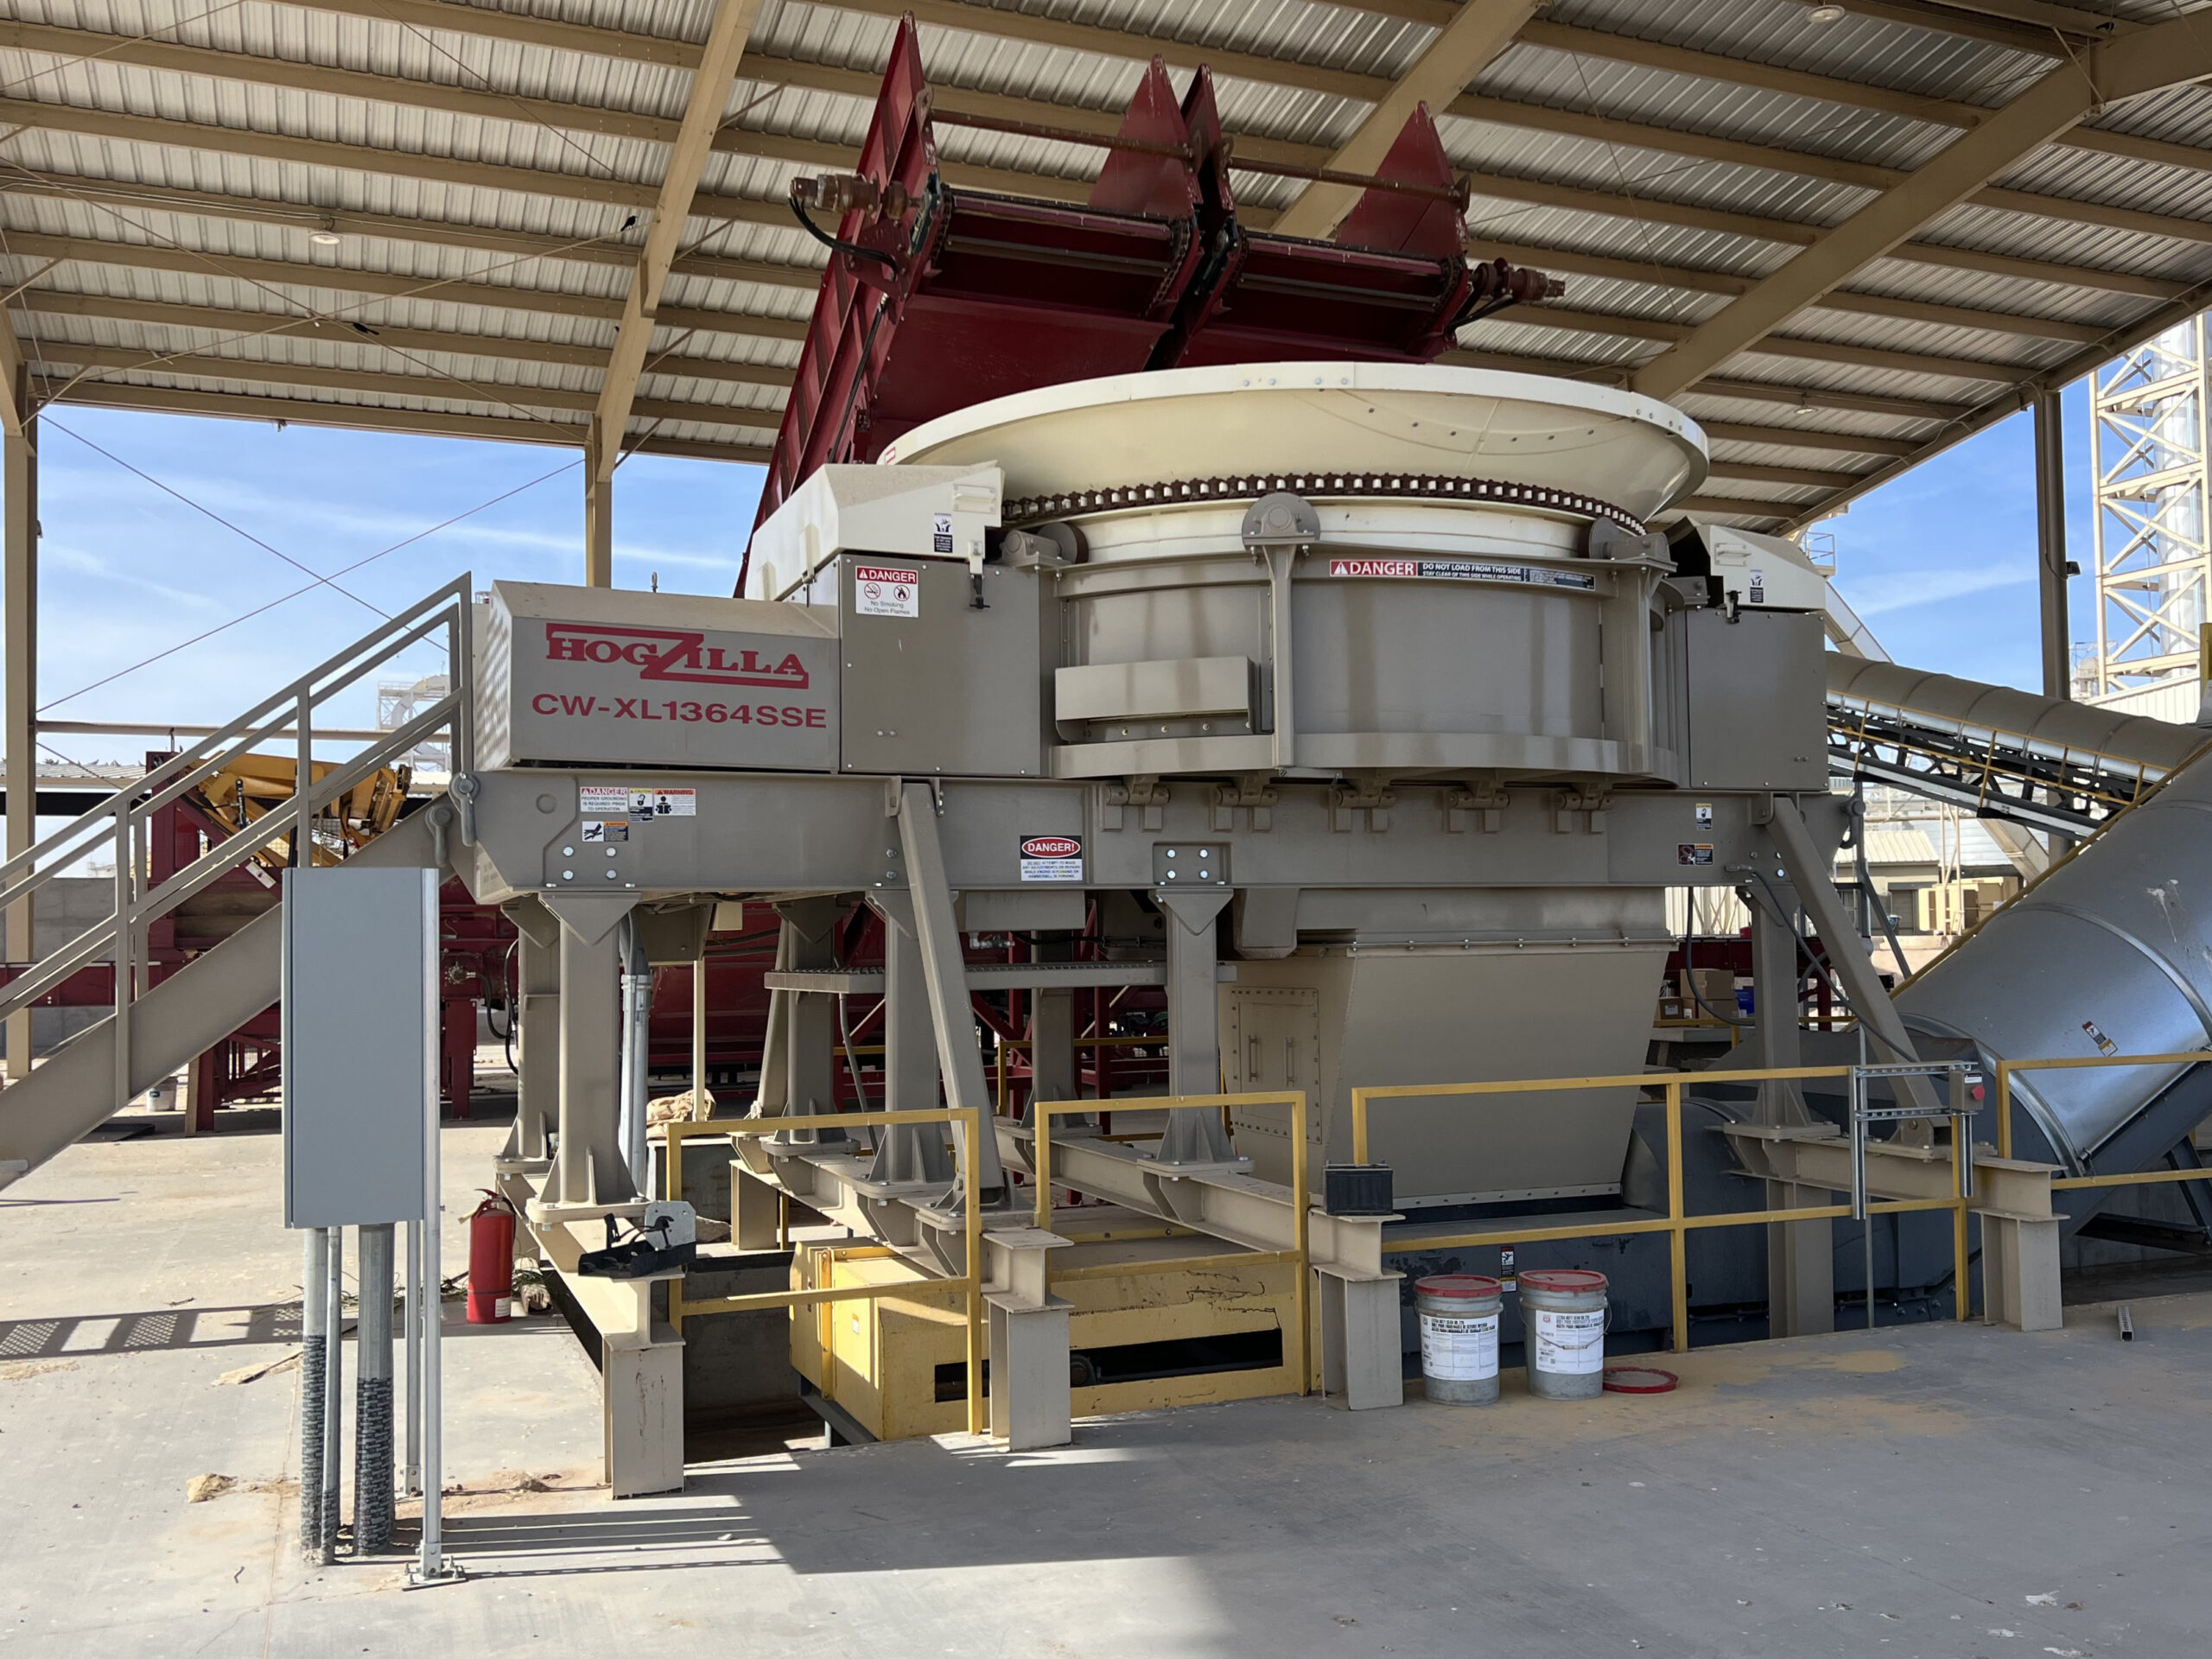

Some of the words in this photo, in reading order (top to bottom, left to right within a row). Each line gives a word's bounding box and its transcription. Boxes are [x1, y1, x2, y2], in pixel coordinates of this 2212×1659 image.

[1349, 562, 1414, 575] DANGER
[868, 570, 916, 582] DANGER
[546, 622, 809, 690] HOGZILLA
[532, 693, 827, 728] CW-XL1364SSE
[1027, 843, 1075, 852] DANGER!
